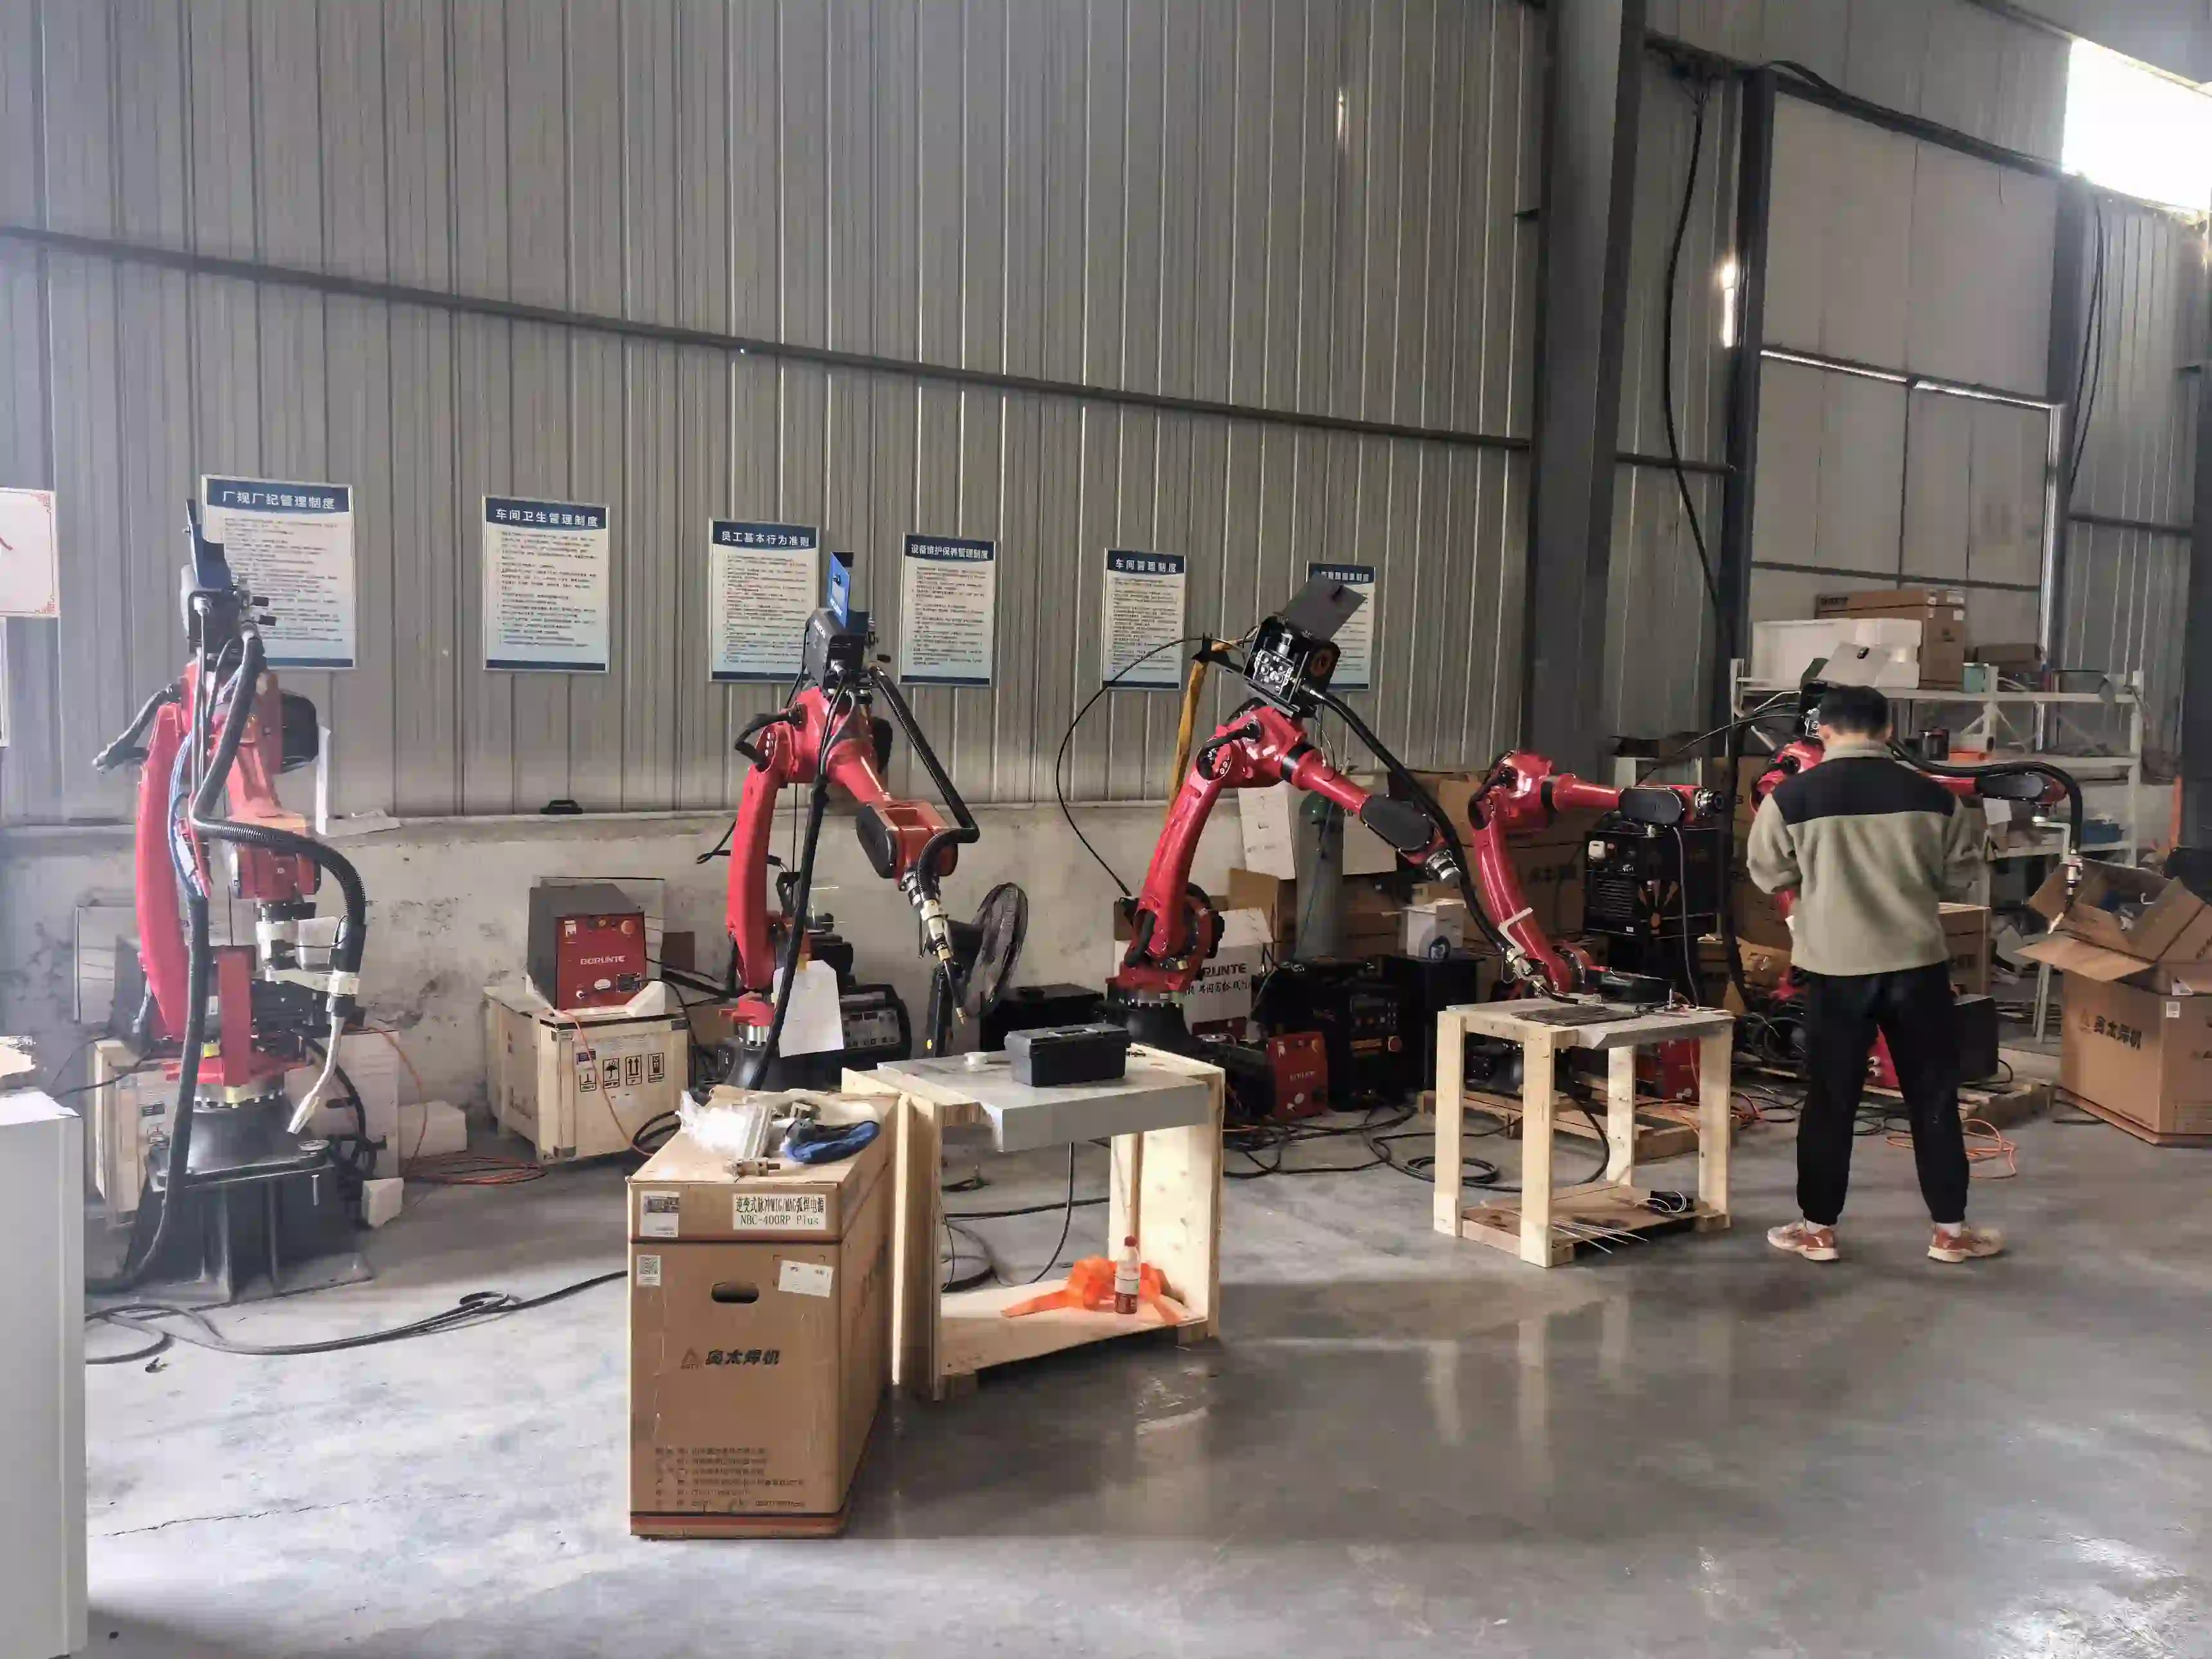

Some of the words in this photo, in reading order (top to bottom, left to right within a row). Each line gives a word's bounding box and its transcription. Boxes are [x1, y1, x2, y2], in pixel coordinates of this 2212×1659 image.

[496, 508, 599, 527] 车间卫生管理制度
[721, 530, 810, 547] 员工基本行为准则
[580, 955, 626, 965] BORUNTE
[1202, 963, 1246, 977] RUNTE
[740, 1215, 791, 1226] NBC-400RP
[797, 1215, 819, 1226] Plus
